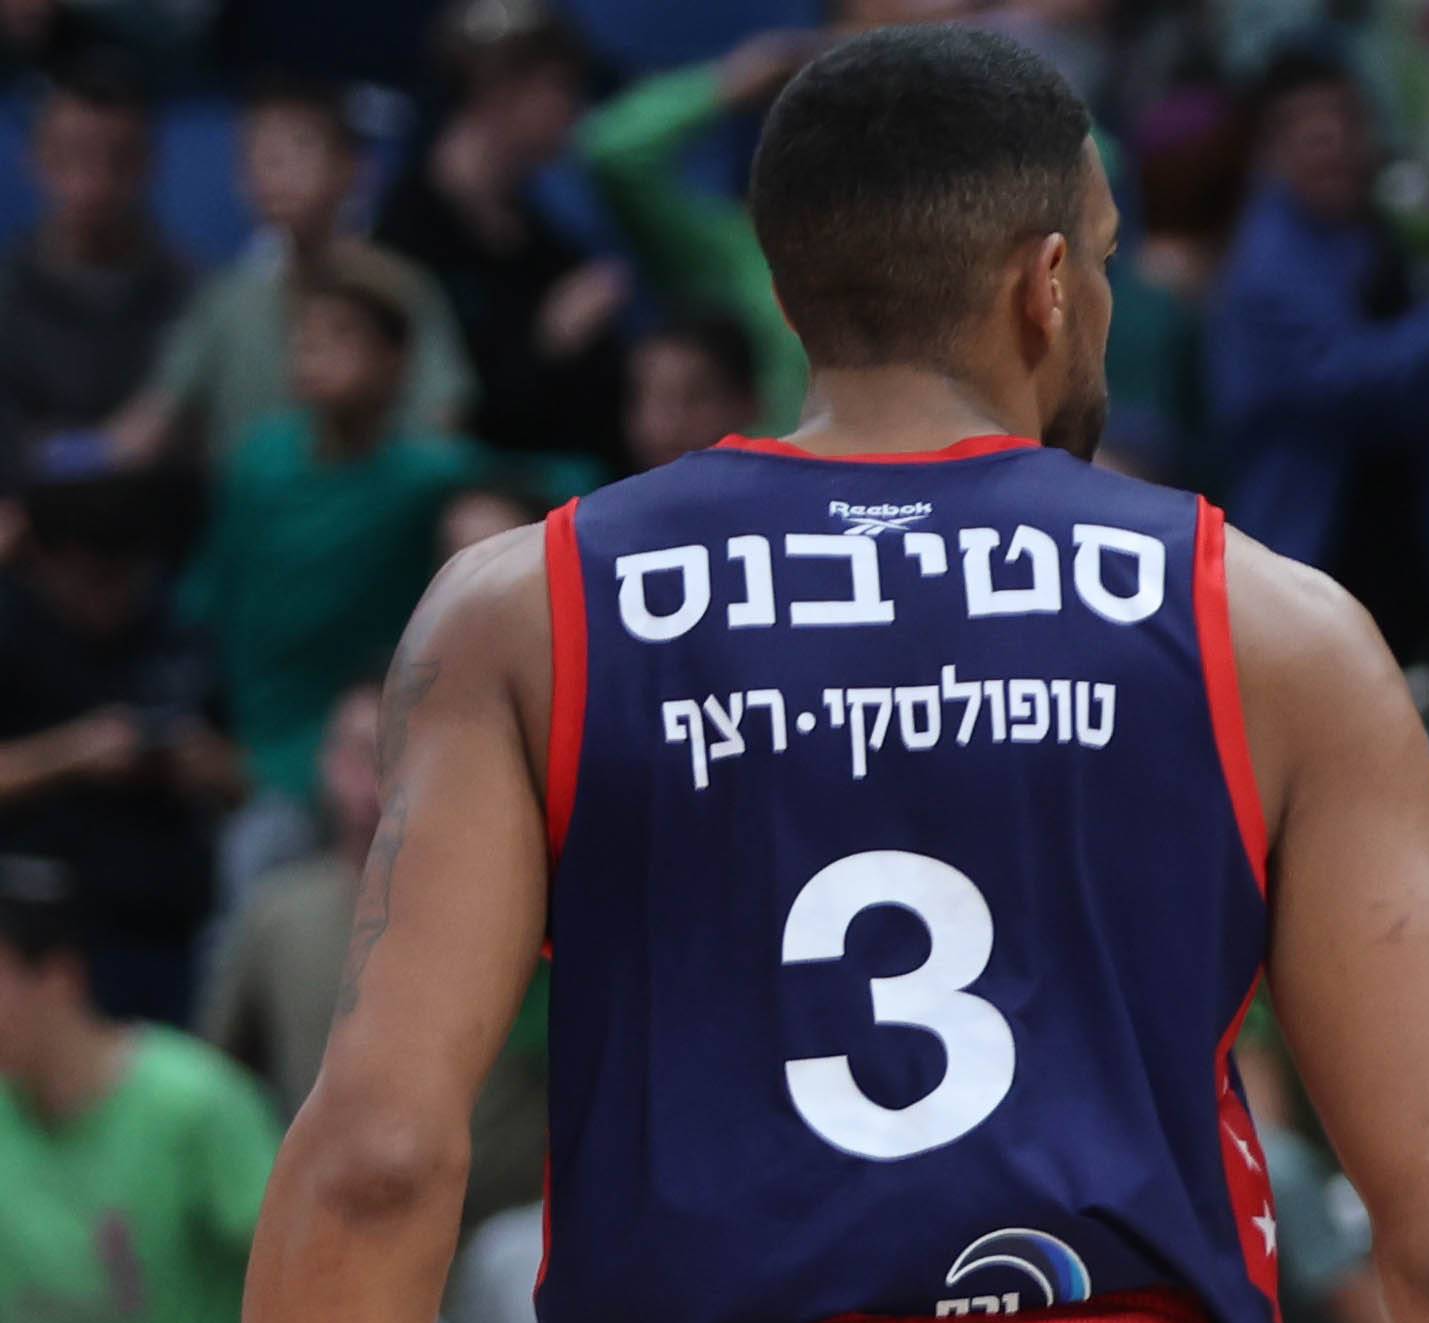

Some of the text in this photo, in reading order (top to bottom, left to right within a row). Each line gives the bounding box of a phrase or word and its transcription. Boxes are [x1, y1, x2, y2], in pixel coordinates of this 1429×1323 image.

[829, 501, 932, 518] Reebok
[615, 523, 1166, 642] סטיבנס
[662, 665, 1116, 790] טופולסקי רצף
[781, 849, 1016, 1162] 3
